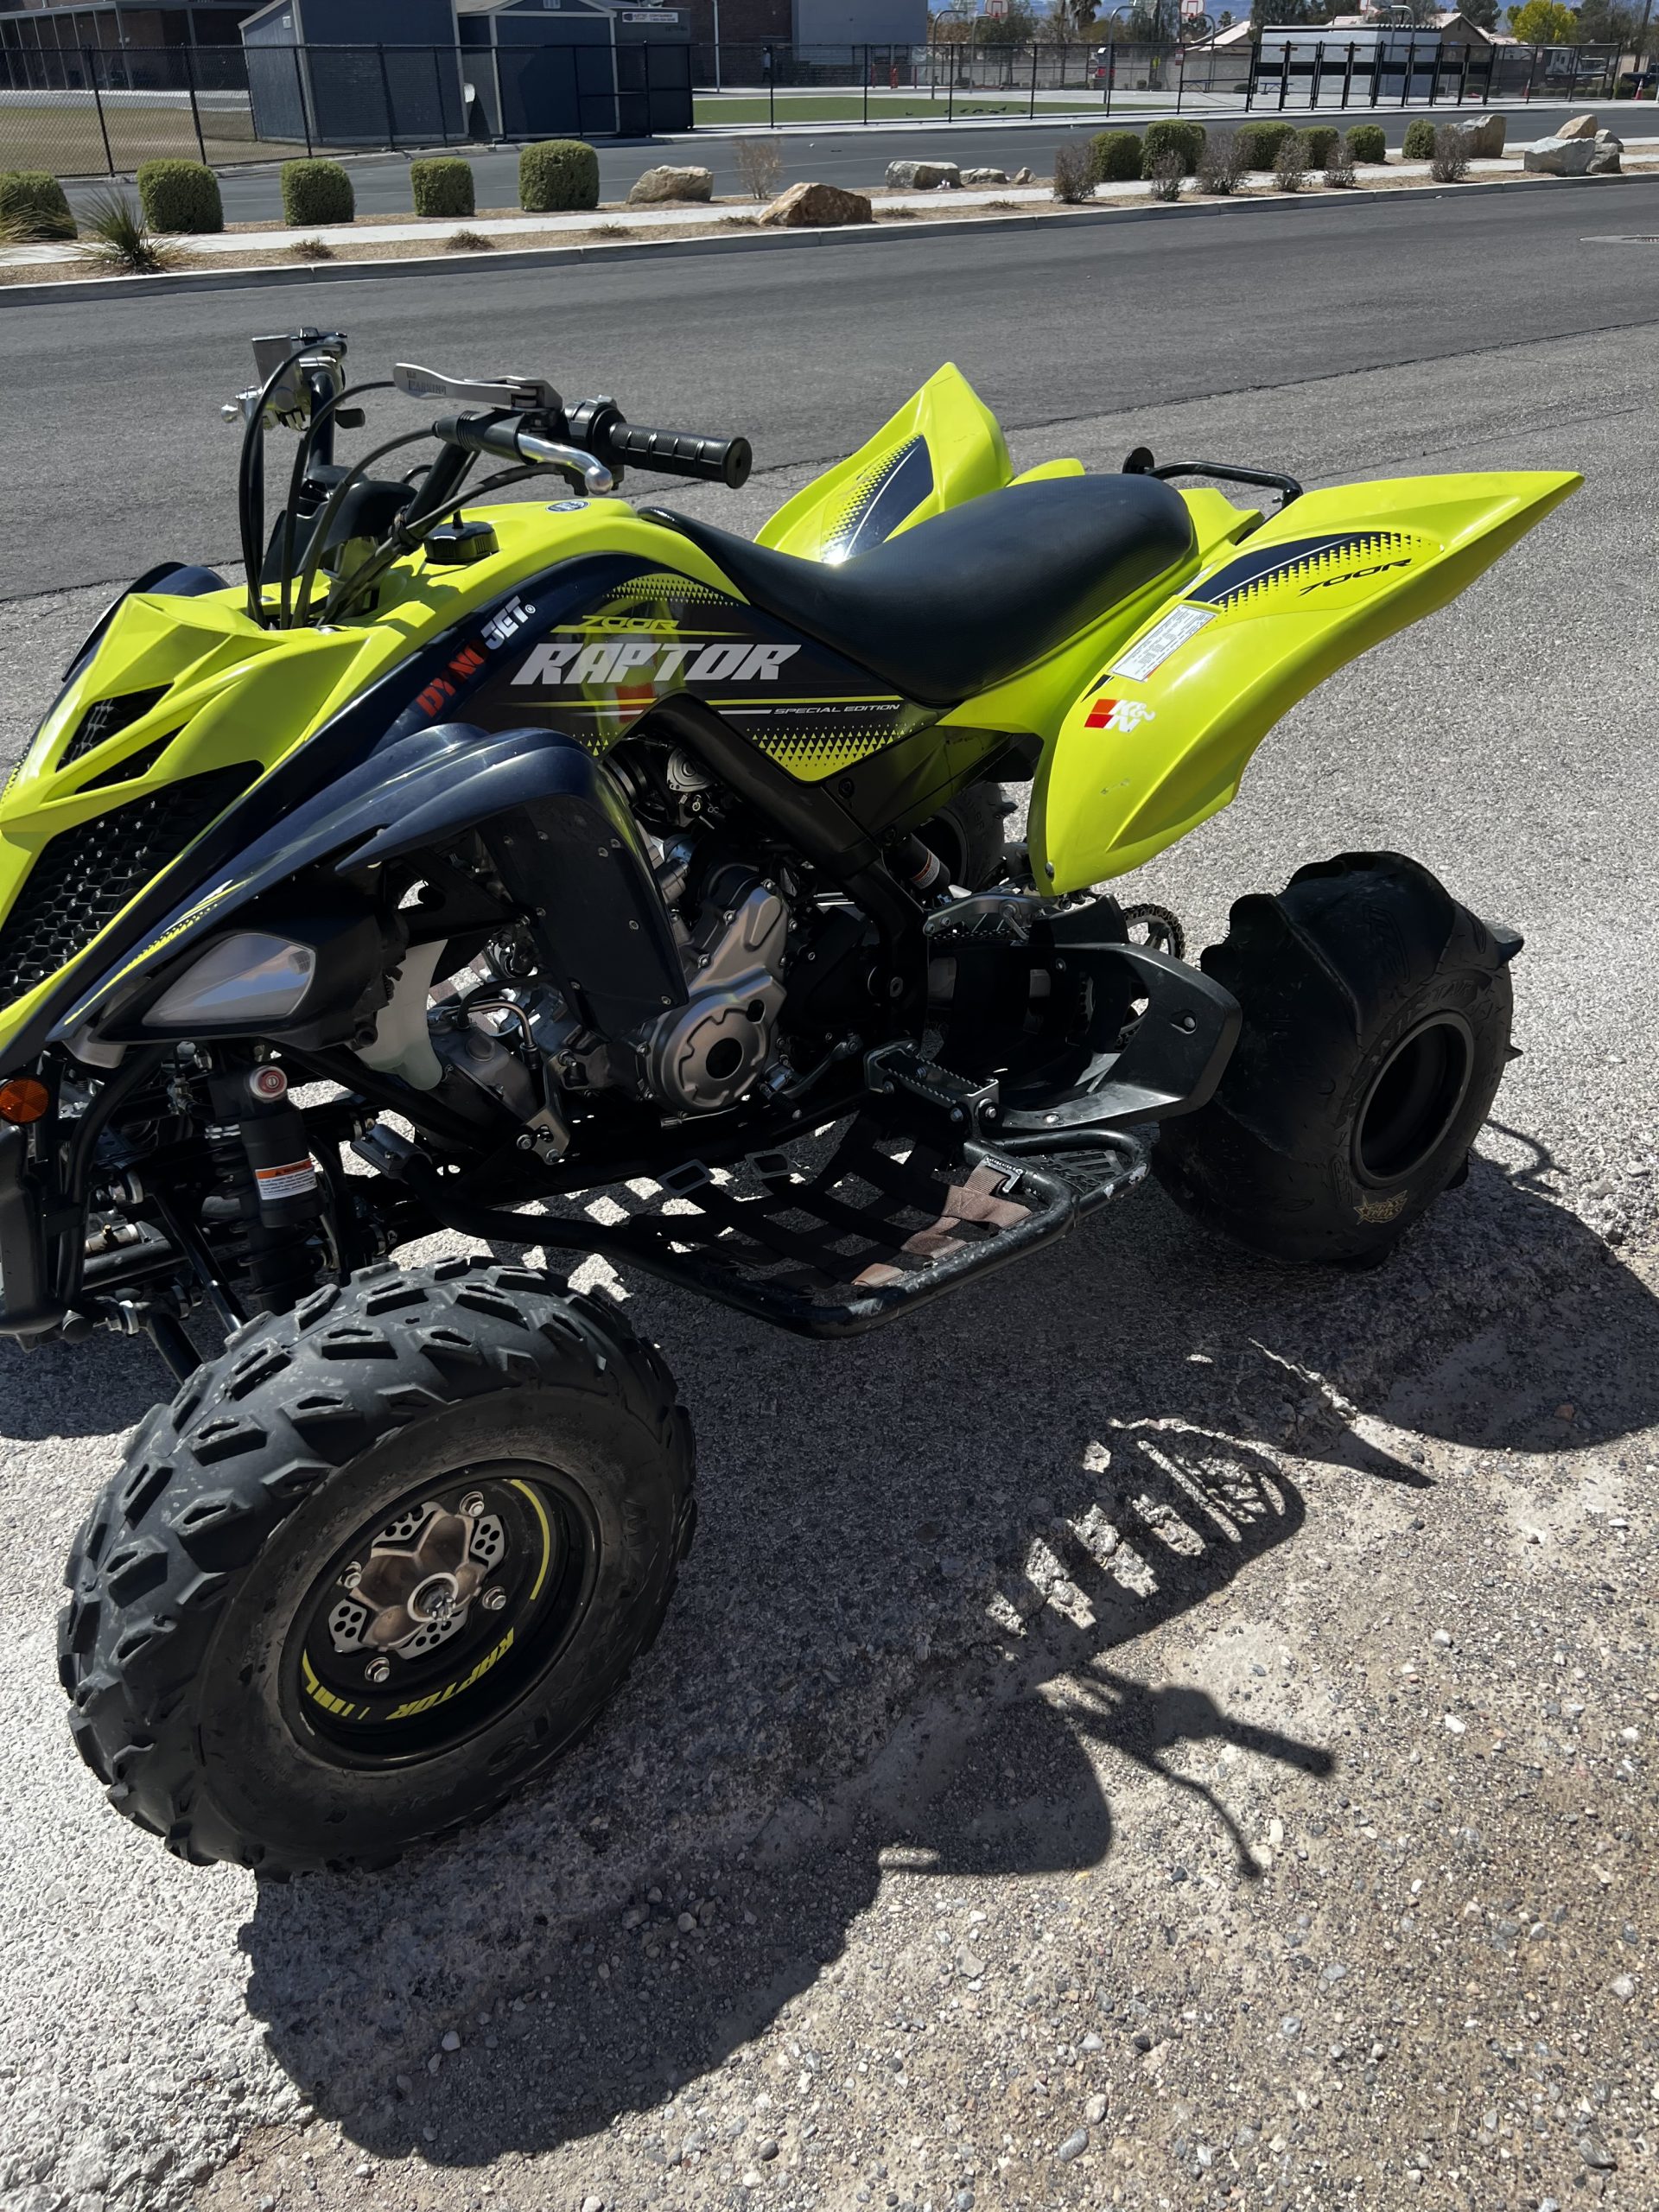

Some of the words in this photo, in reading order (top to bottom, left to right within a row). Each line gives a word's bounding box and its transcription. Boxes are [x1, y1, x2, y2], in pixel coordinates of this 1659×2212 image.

[1298, 558, 1412, 596] 700R
[510, 643, 802, 685] RAPTOR
[385, 1627, 514, 1719] RAPTOR
